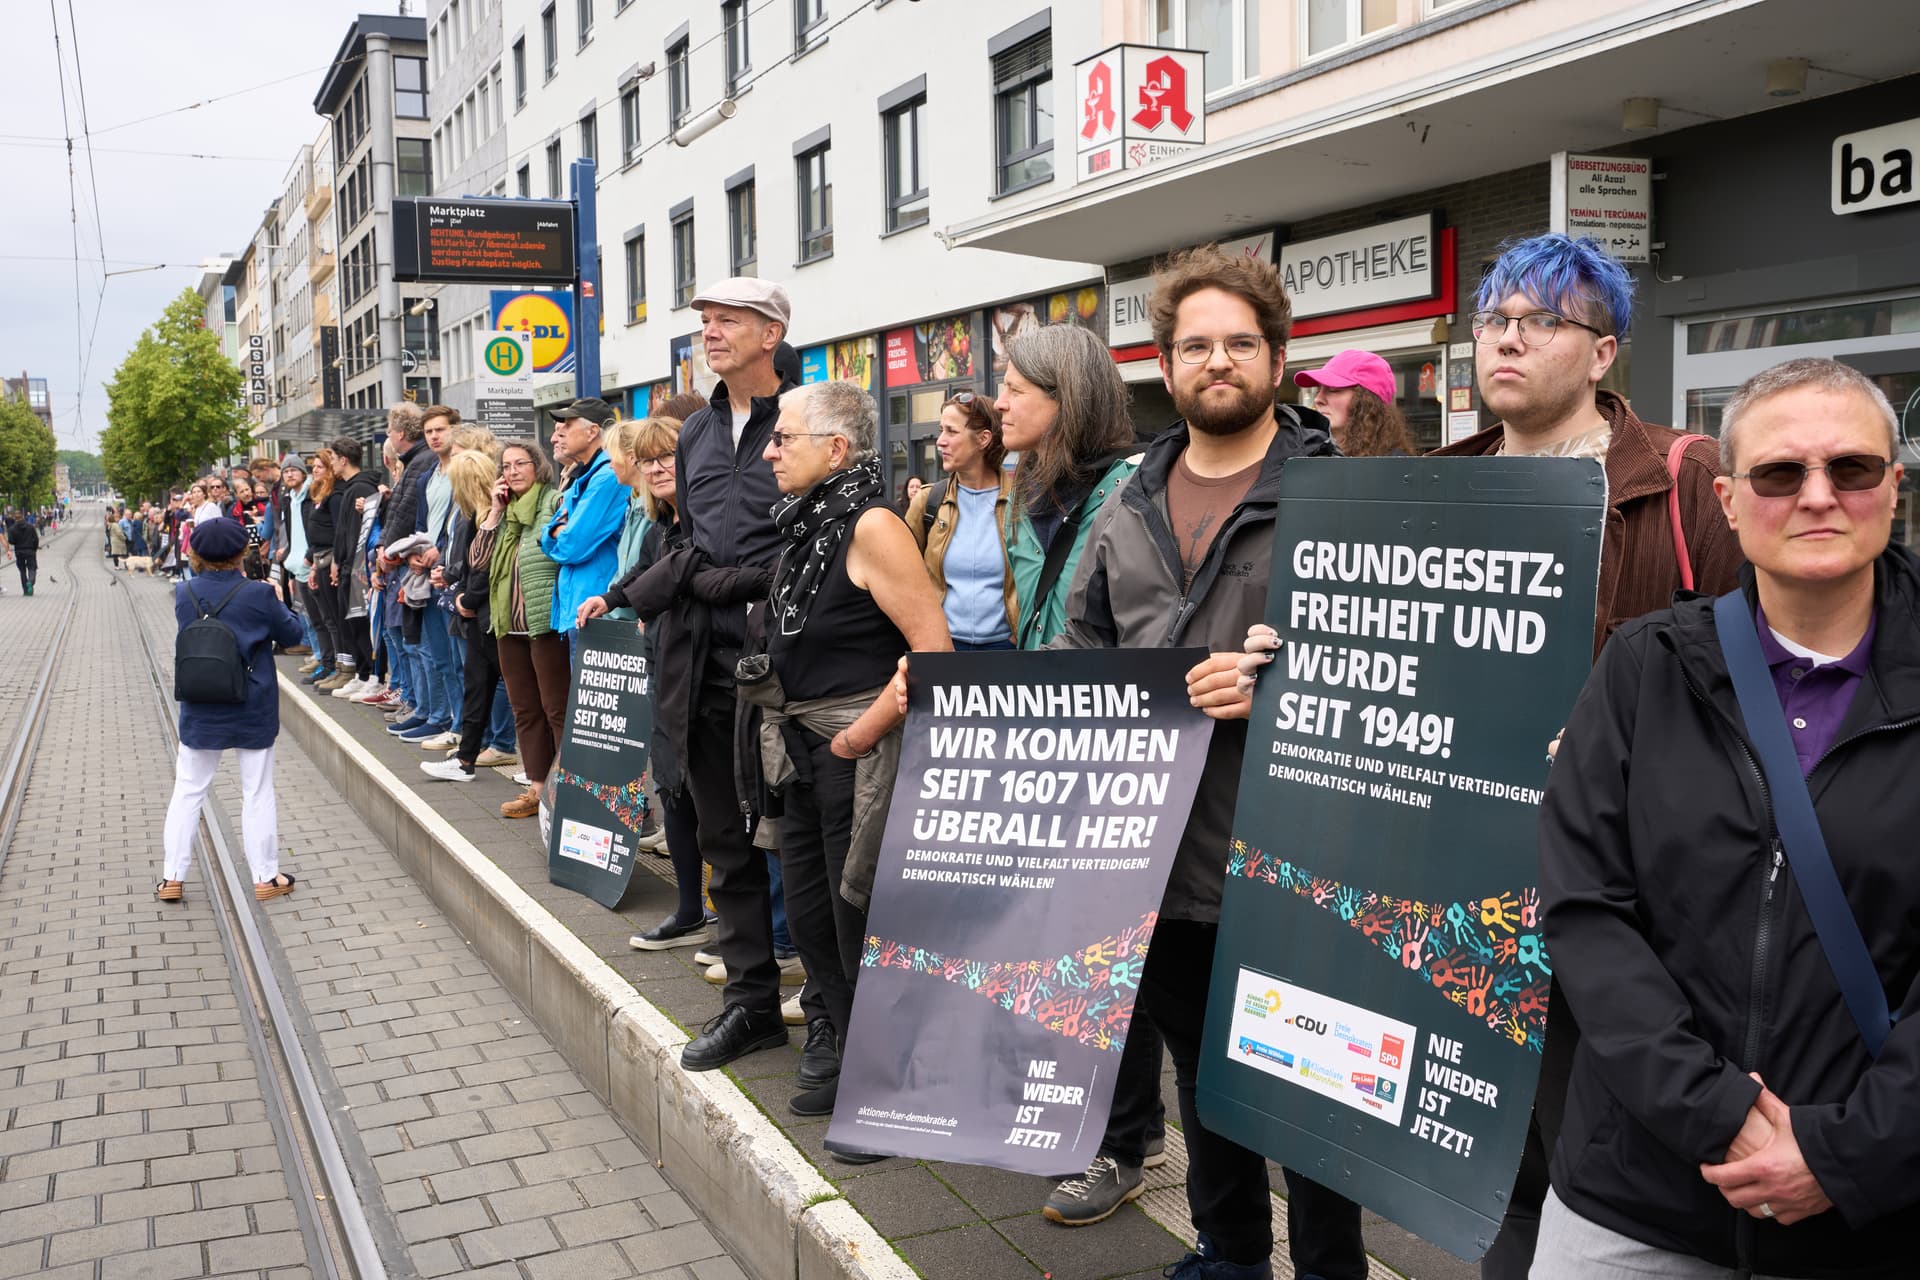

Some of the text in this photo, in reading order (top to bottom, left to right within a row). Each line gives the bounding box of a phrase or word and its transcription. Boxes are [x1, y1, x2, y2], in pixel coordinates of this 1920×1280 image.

[1150, 145, 1191, 156] EINHO
[1570, 157, 1647, 174] ÜBERSETZUNGSBÜRO
[1841, 143, 1913, 205] ba
[1592, 174, 1602, 182] Ali
[1580, 184, 1637, 197] alle Sprachen
[430, 206, 486, 218] Marktplatz
[1570, 219, 1606, 228] Translations
[1604, 208, 1647, 220] TERCÜMAN
[468, 230, 515, 240] Kundgebung
[431, 249, 460, 257] werden
[462, 249, 481, 257] nicht
[432, 258, 542, 270] Zustieg Paradeplatz möglich.
[1283, 235, 1428, 295] APOTHEKE
[1114, 293, 1149, 326] EIN
[496, 345, 512, 367] H
[251, 336, 264, 404] OSCAR
[488, 387, 523, 396] Marktplatz
[1293, 540, 1564, 598] GRUNDGESETZ:
[1290, 591, 1546, 654] FREIHEIT UND
[583, 649, 647, 674] GRUNDGESET
[1288, 642, 1419, 697] WÜRDE
[580, 669, 626, 692] FREIHEIT
[578, 688, 619, 711] WÜRDE
[932, 684, 1150, 718] MANNHEIM:
[574, 709, 627, 734] SEIT 1949!
[1276, 692, 1454, 758] SEIT 1949!
[930, 727, 1179, 762] WIR KOMMEN
[1272, 741, 1352, 768] DEMOKRATIE
[1355, 756, 1384, 773] UND
[1388, 762, 1446, 786] VIELFALT
[920, 768, 1170, 806] SEIT 1607 VON
[1269, 764, 1432, 809] DEMOKRATISCH WÄHLEN!
[912, 809, 1158, 849] ÜBERALL HER!
[906, 849, 1150, 870] DEMOKRATIE UND VIELFALT VERTEIDIGEN!
[902, 868, 1054, 889] DEMOKRATISCH WÄHLEN!
[1295, 1015, 1327, 1036] CDU
[1336, 1022, 1351, 1033] Freie
[1334, 1030, 1373, 1049] Demokraten
[1428, 1033, 1463, 1064] NIE
[1028, 1060, 1057, 1080] NIE
[1381, 1051, 1398, 1066] SPD
[1310, 1070, 1343, 1090] Mannheim
[1311, 1062, 1344, 1081] Klimaliste
[1023, 1082, 1084, 1106] WIEDER
[1424, 1060, 1498, 1108] WIEDER
[1418, 1088, 1451, 1117] IST
[858, 1106, 958, 1128] aktionen-fuer-demokratie.de
[1016, 1106, 1044, 1124] IST
[1004, 1126, 1061, 1150] JETZT!
[1410, 1114, 1474, 1158] JETZT!
